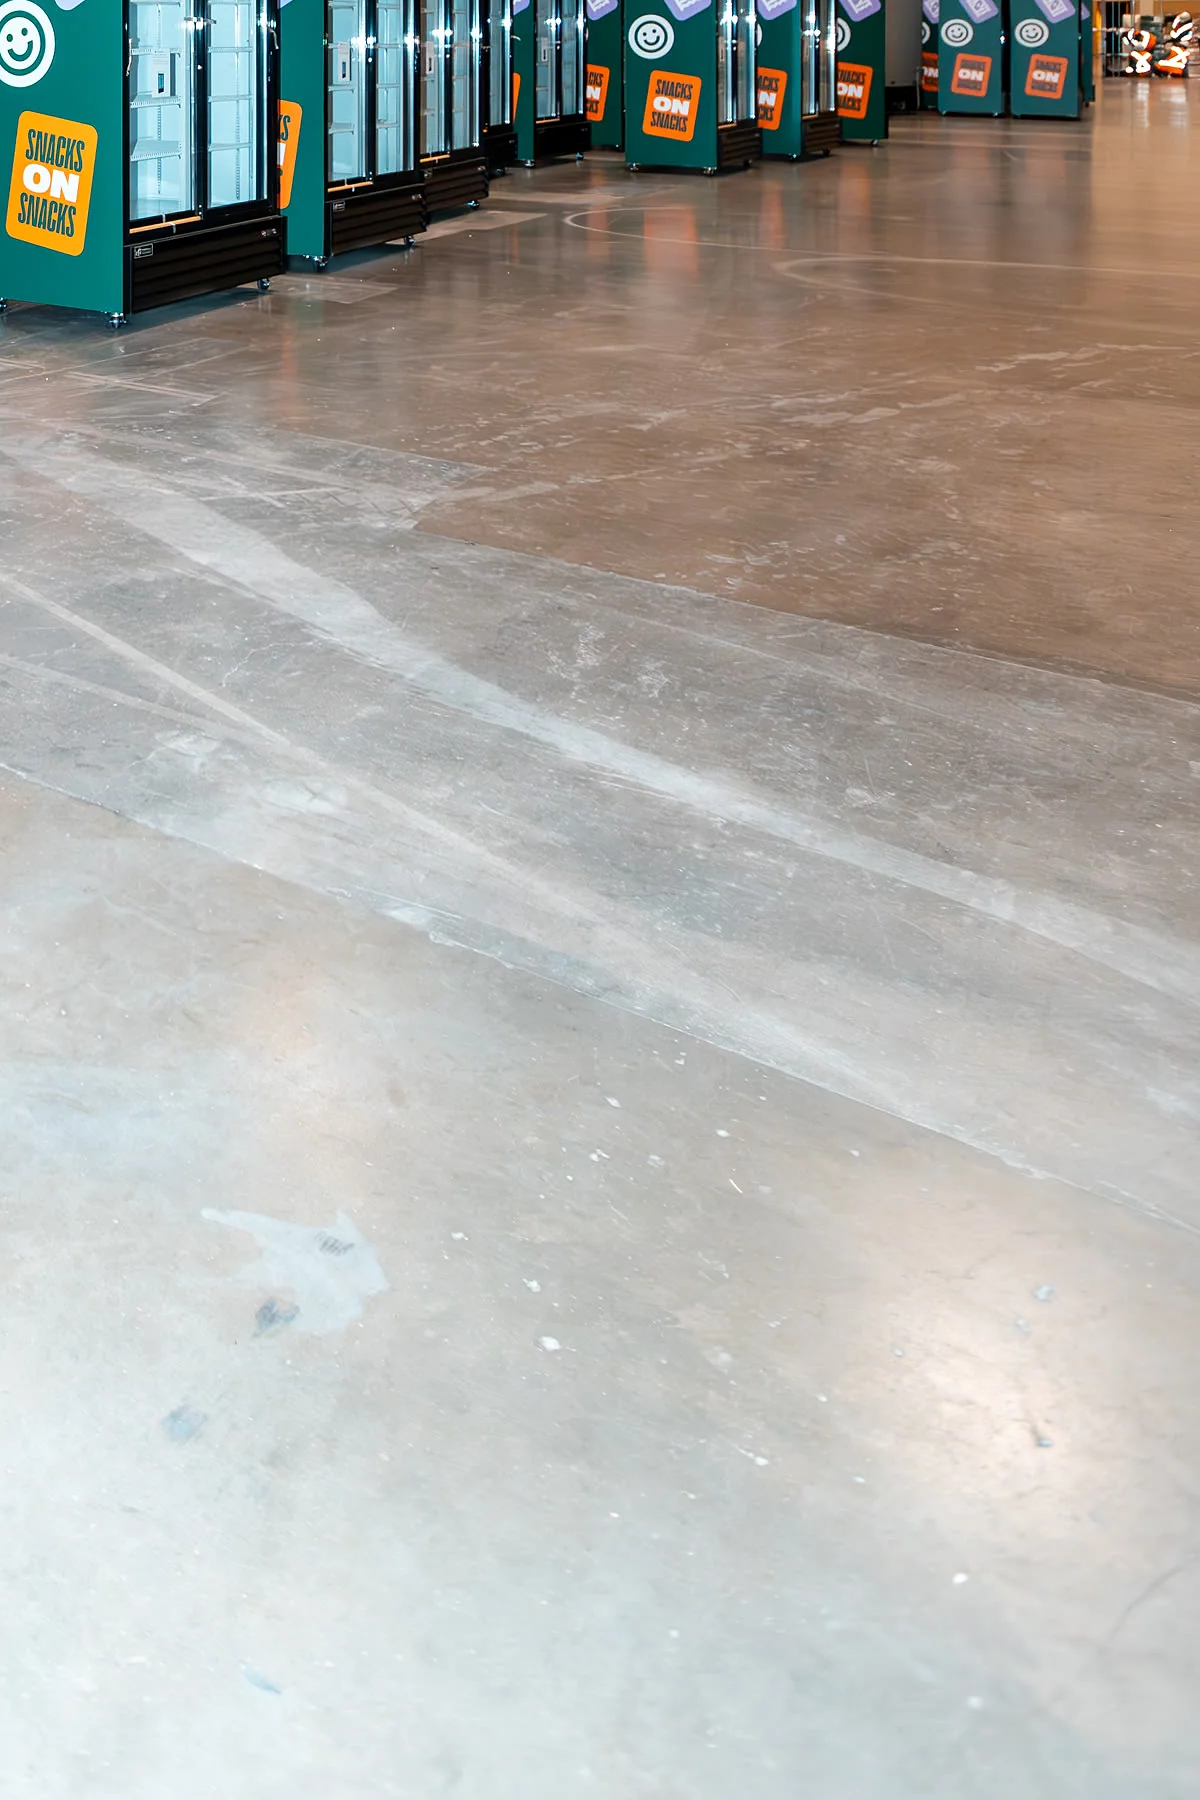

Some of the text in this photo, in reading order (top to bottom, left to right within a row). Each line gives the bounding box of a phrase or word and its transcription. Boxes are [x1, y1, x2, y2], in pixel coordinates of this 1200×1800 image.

[958, 68, 984, 81] ON
[1032, 70, 1059, 83] ON
[586, 85, 601, 100] N
[655, 79, 694, 99] SNACKS
[758, 90, 777, 107] N
[653, 96, 690, 115] ON
[650, 111, 688, 132] SNACKS
[25, 128, 85, 173] SNACKS
[22, 163, 80, 203] ON
[17, 192, 77, 237] SNACKS
